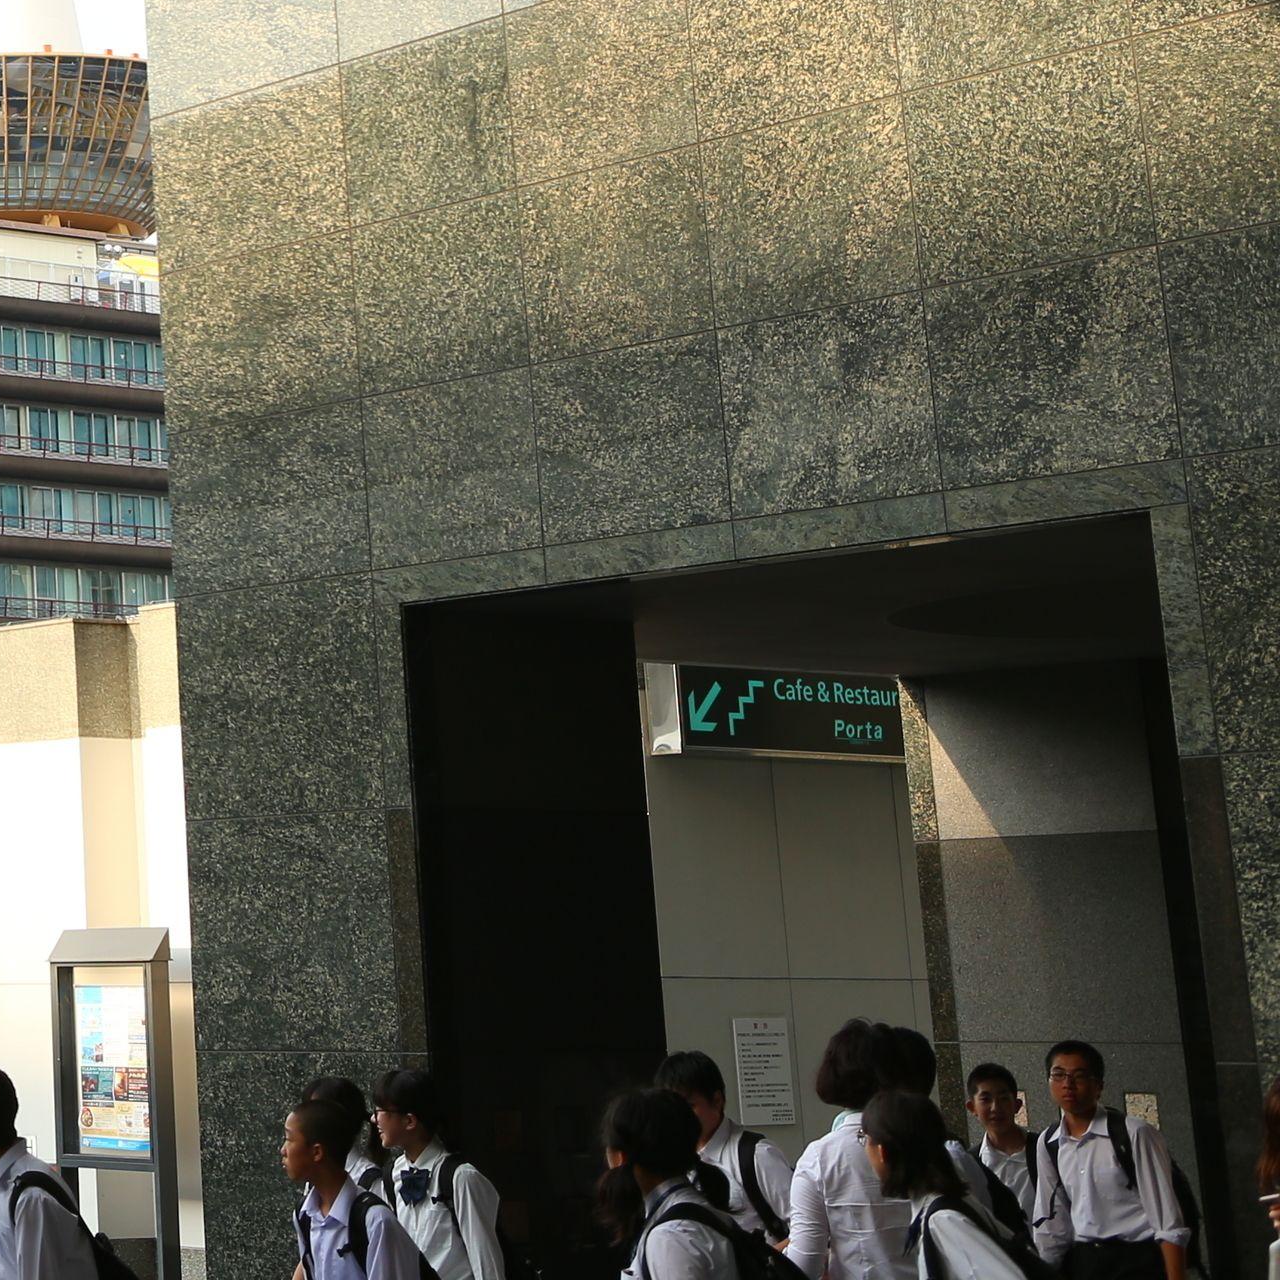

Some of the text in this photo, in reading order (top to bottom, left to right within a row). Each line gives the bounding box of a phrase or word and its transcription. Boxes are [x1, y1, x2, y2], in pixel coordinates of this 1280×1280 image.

[773, 678, 898, 707] Cafe & Restaur
[834, 719, 883, 740] Porta
